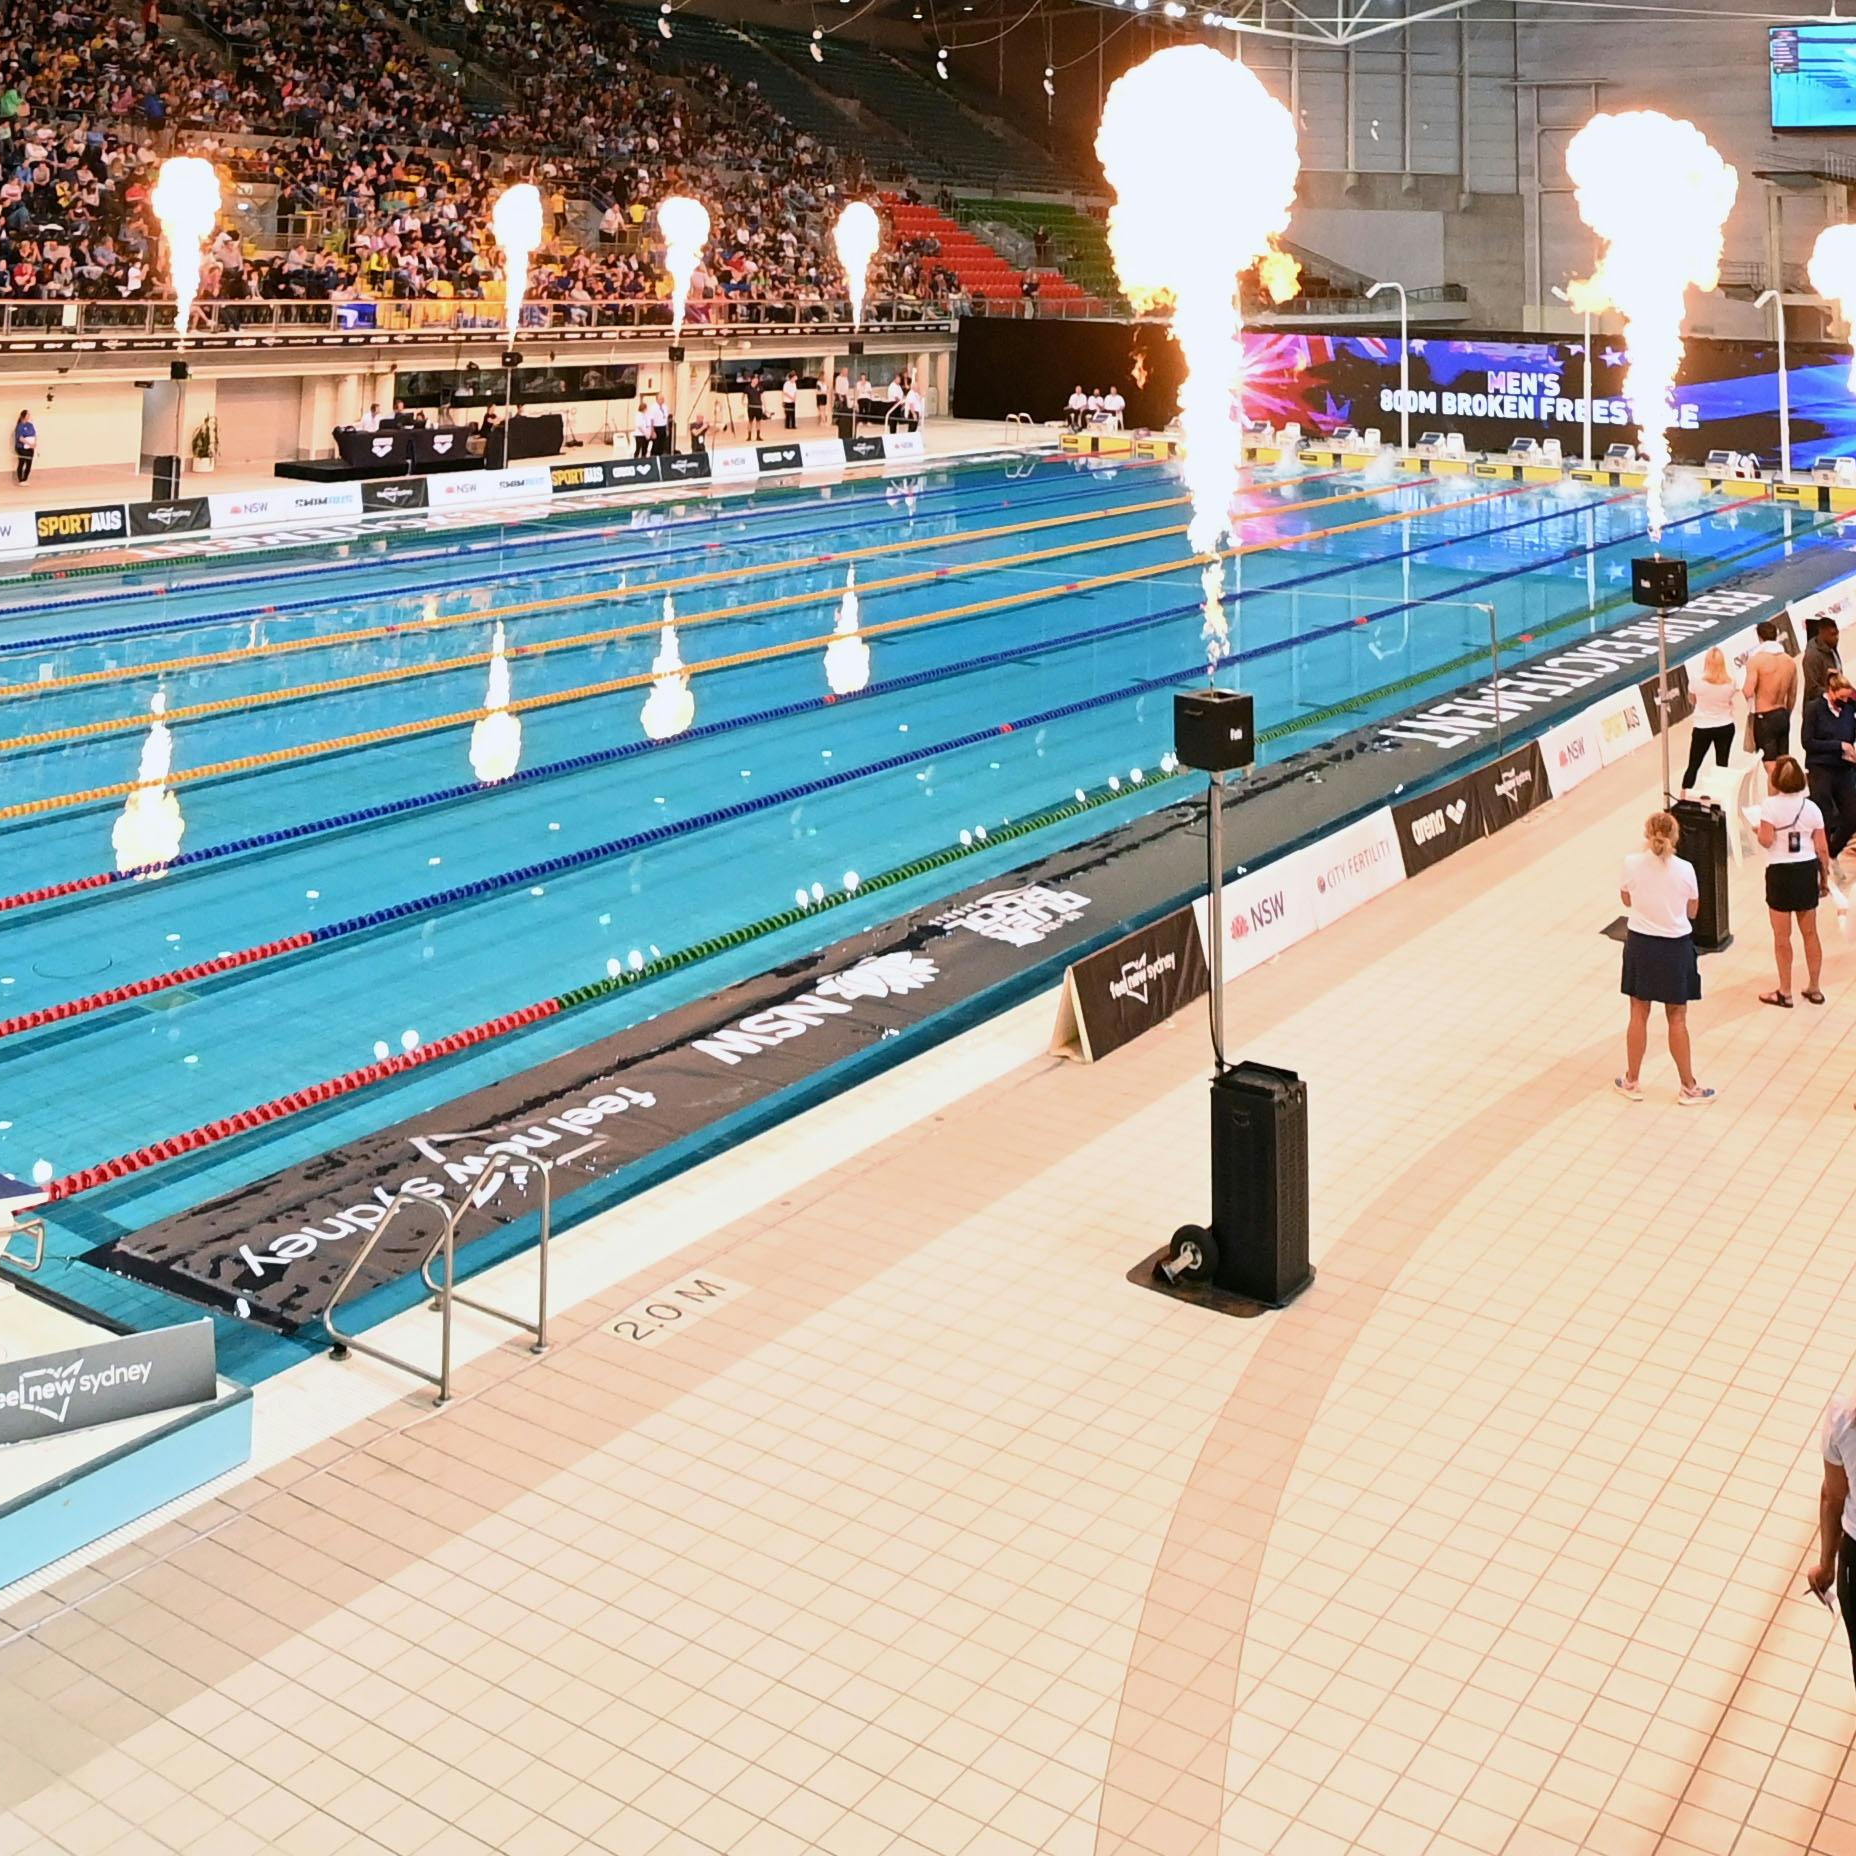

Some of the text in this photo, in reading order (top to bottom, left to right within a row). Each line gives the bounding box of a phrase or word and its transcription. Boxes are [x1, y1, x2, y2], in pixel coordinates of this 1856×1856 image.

[1487, 370, 1561, 396] MEN'S
[1379, 389, 1437, 415] 800M
[1441, 391, 1535, 421] BROKEN
[37, 510, 123, 538] SPORTAUS
[243, 501, 269, 515] NSW
[1666, 590, 1775, 617] FEEL
[1610, 615, 1720, 644] THE
[1377, 637, 1661, 750] EXCITEMENT
[1568, 734, 1586, 764] NSW
[1410, 807, 1446, 846] arena
[1326, 838, 1392, 889] CITY FERTILITY
[1249, 890, 1286, 933] NSW
[1127, 965, 1147, 988] new
[1146, 950, 1177, 980] sydney
[691, 993, 854, 1066] NSW
[237, 1085, 657, 1278] feel new sydney
[613, 1278, 729, 1344] 2.0 M
[28, 1376, 77, 1402] new
[78, 1360, 153, 1395] sydney
